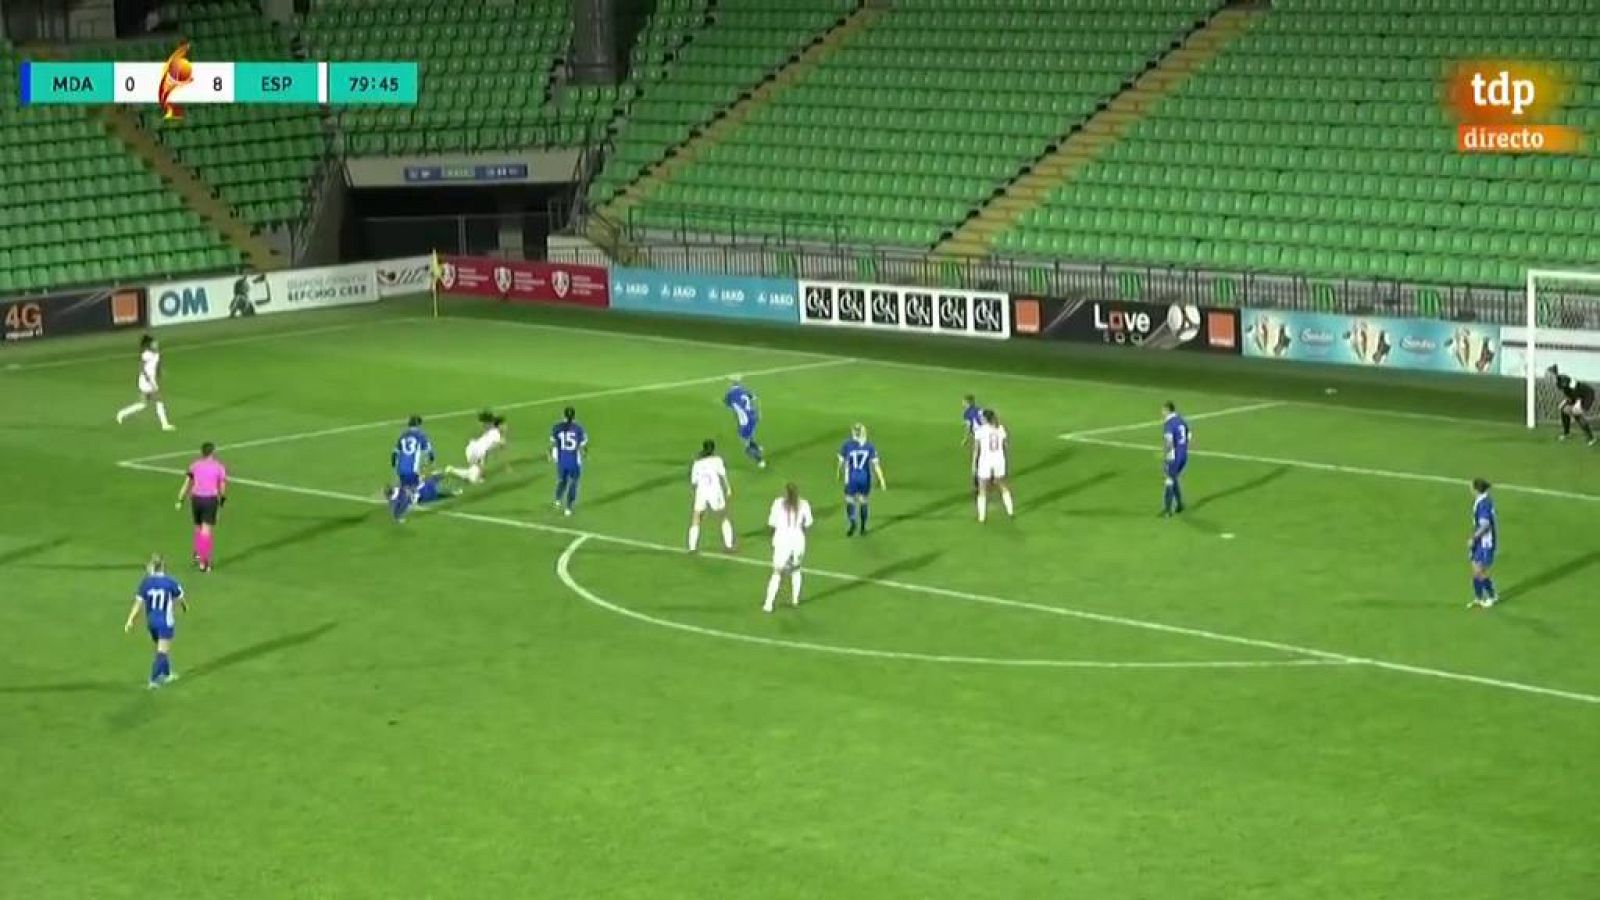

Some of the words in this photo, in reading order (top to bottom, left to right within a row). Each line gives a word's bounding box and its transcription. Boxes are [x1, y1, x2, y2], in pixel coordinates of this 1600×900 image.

[158, 287, 209, 317] OM
[5, 303, 42, 329] 4G
[1094, 303, 1151, 333] Love
[557, 432, 577, 451] 15
[1178, 425, 1187, 443] 3
[401, 436, 417, 455] 13
[849, 450, 870, 470] 17
[147, 589, 165, 611] 11
